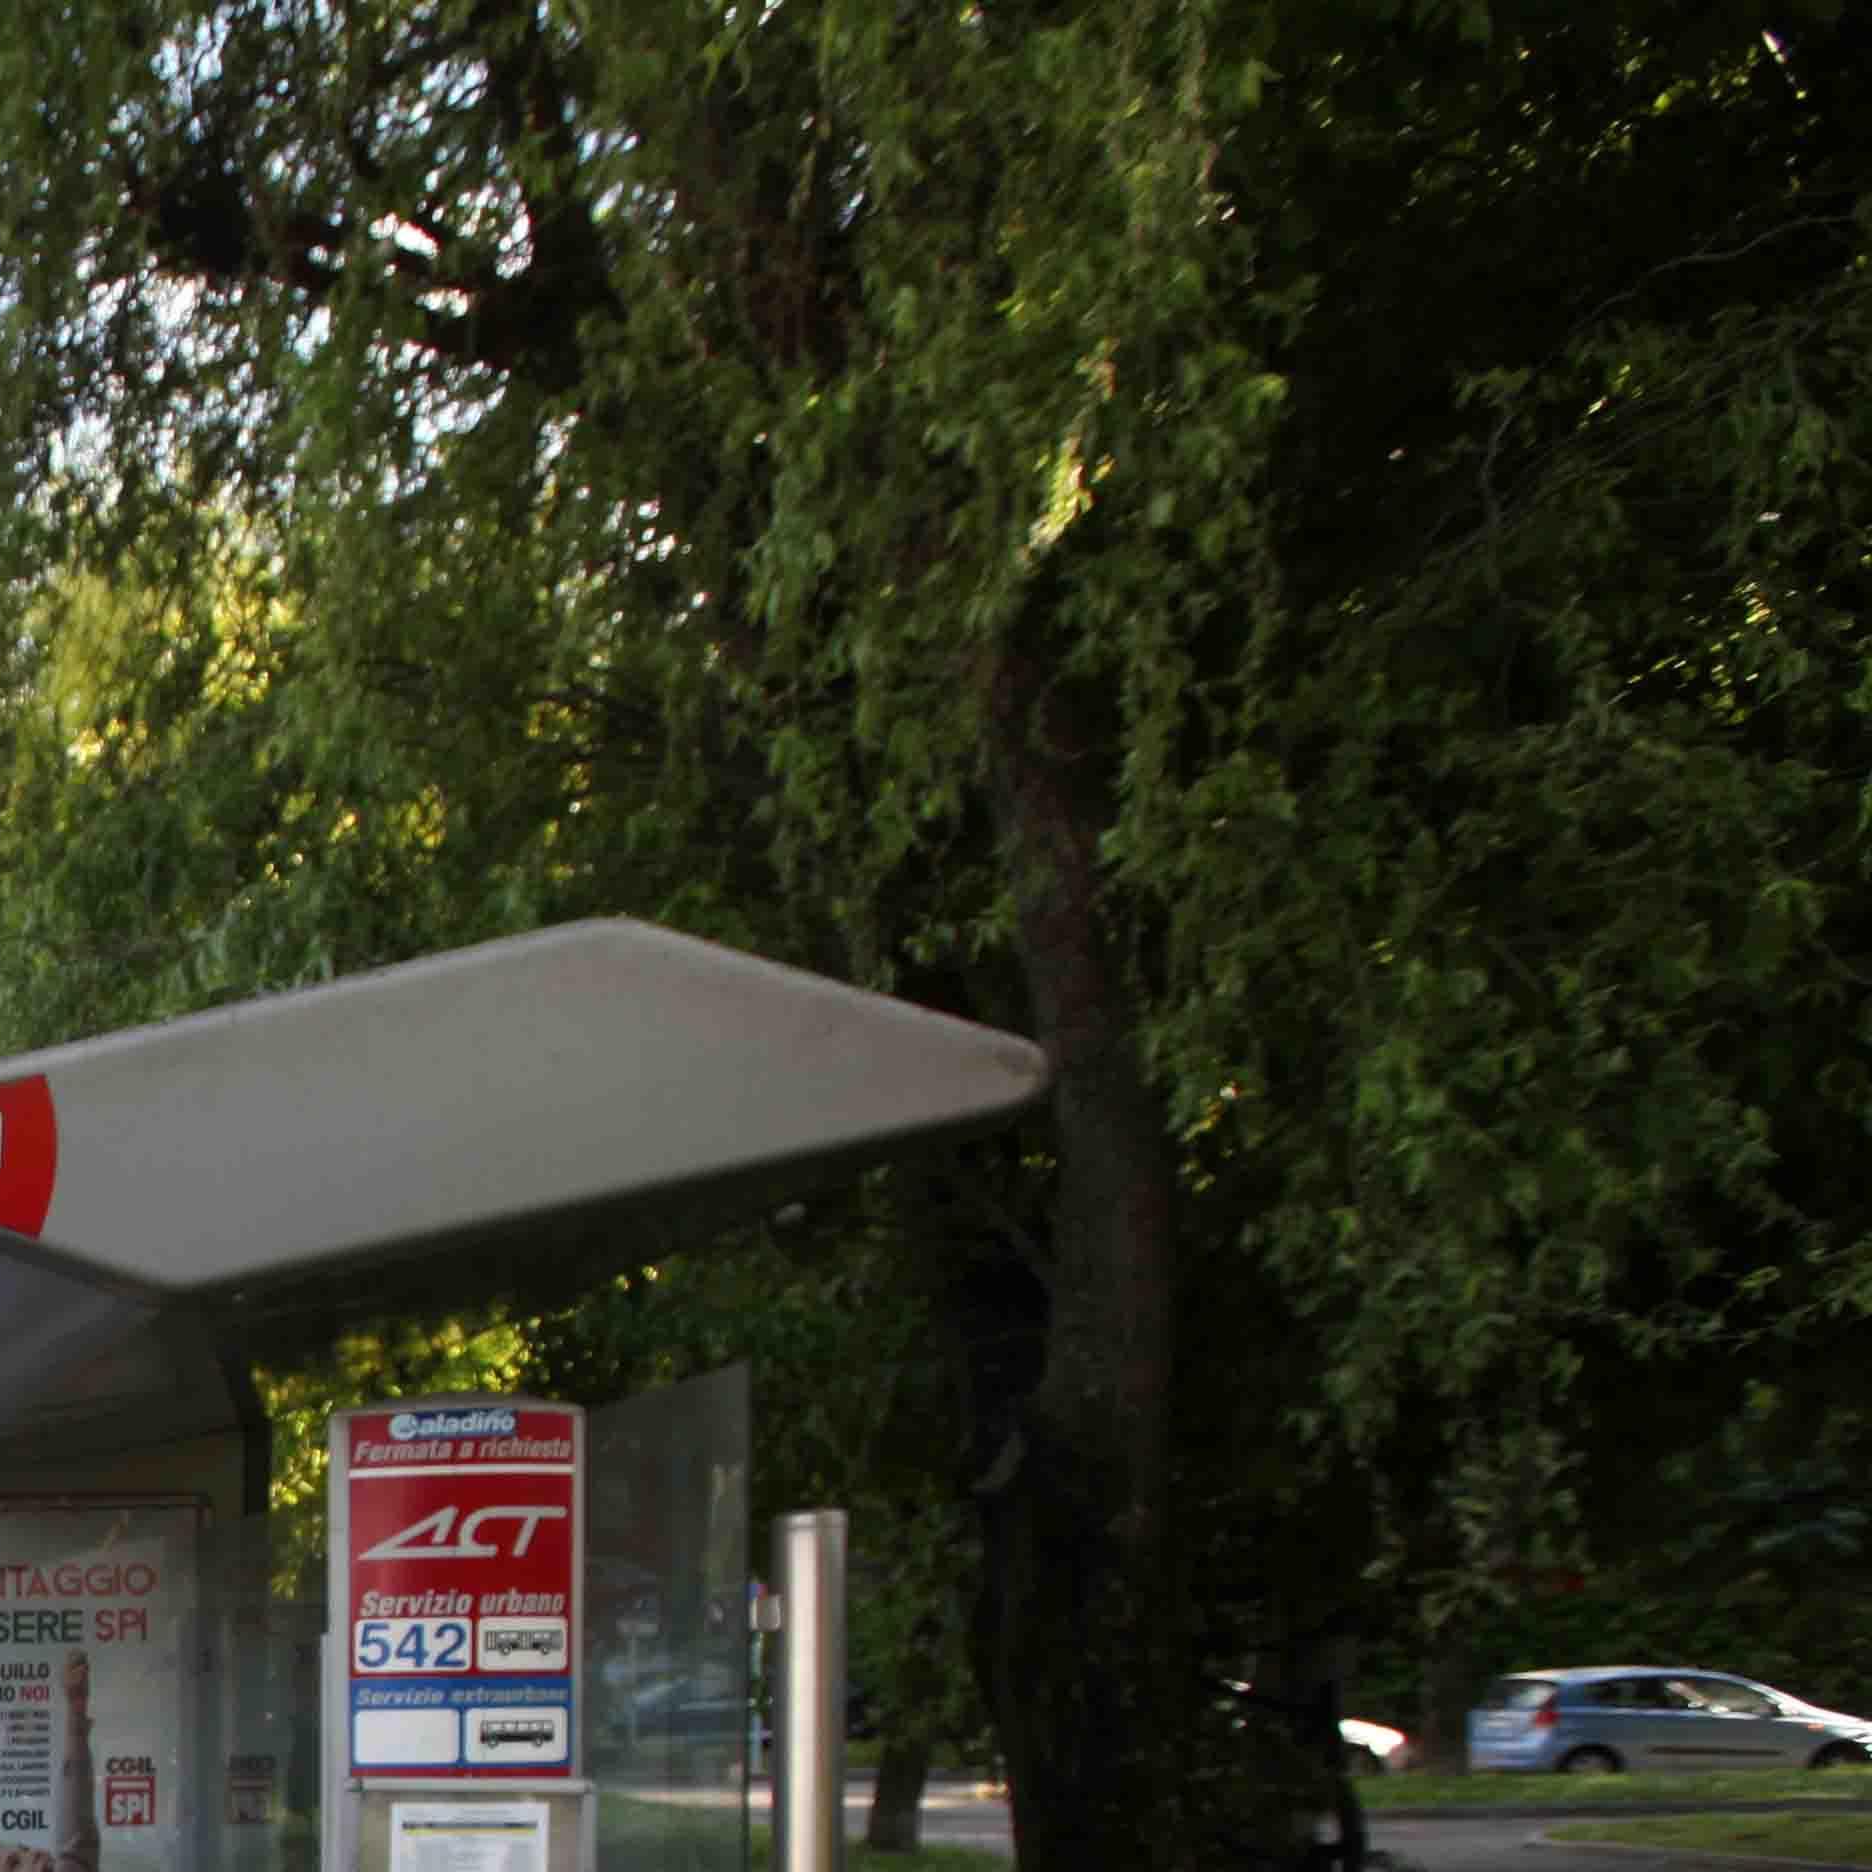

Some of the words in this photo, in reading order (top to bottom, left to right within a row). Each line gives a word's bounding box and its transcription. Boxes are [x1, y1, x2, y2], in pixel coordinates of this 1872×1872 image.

[354, 1441, 453, 1463] Fermata
[458, 1441, 474, 1459] a
[479, 1438, 571, 1460] richiesta
[357, 1505, 567, 1560] ACT
[360, 1589, 472, 1617] Servizio
[480, 1588, 564, 1614] urbano
[95, 1608, 149, 1642] SPI
[358, 1623, 466, 1668] 542
[19, 1685, 50, 1702] NOI
[106, 1757, 157, 1775] CGIL
[2, 1809, 49, 1831] CGIL
[111, 1793, 151, 1822] SPI
